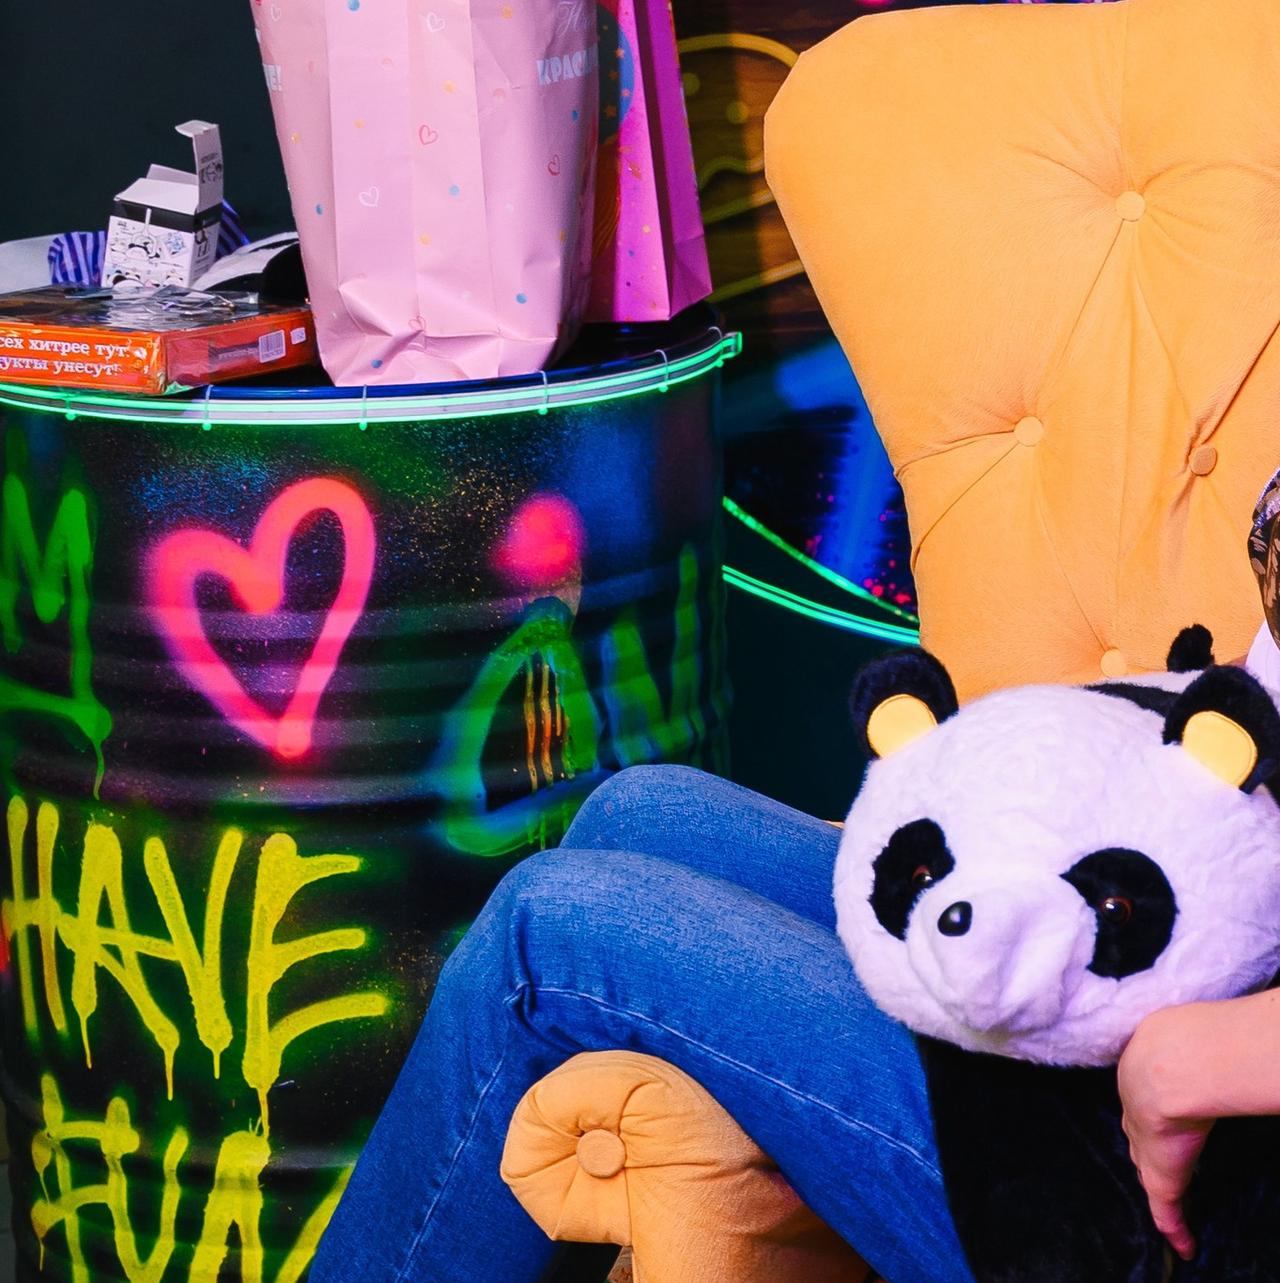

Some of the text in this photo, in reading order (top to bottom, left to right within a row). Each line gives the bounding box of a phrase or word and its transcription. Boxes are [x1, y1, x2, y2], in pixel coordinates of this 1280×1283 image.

[29, 338, 90, 356] хитрее
[0, 355, 49, 371] укты
[2, 796, 389, 1102] HAVE
